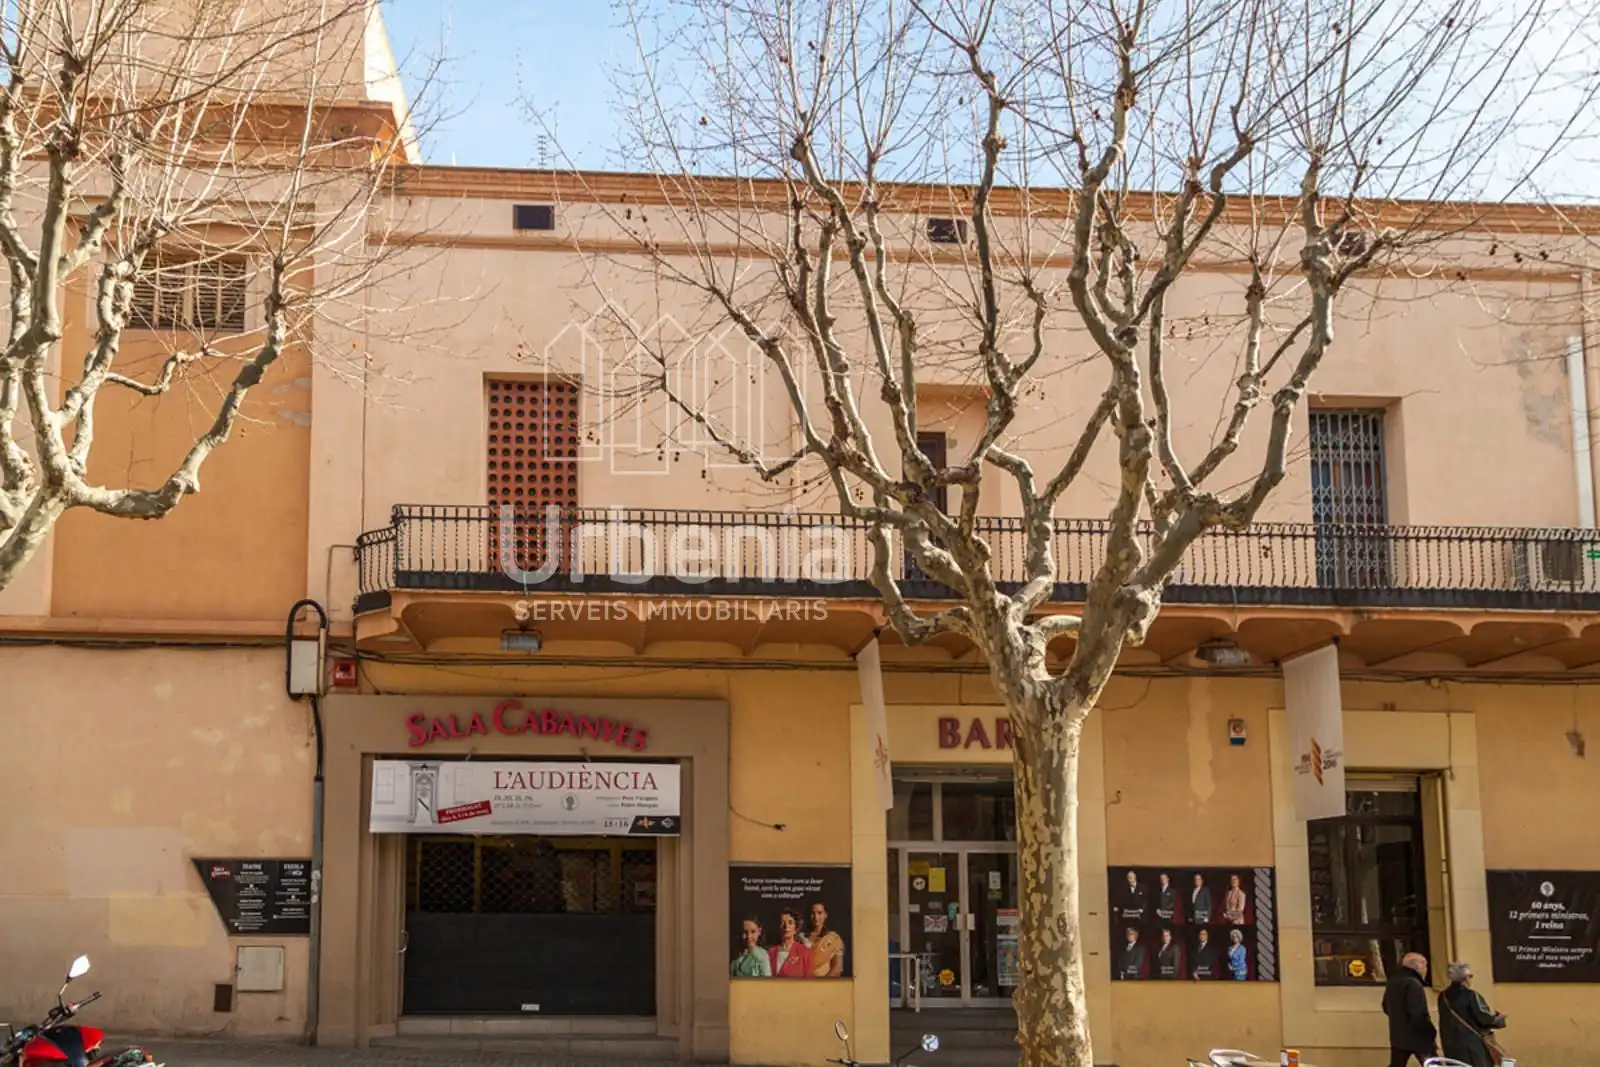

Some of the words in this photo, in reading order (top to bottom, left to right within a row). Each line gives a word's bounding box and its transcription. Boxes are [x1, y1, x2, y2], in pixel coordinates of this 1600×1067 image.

[406, 711, 487, 748] SALA
[492, 699, 648, 751] CABANYES
[938, 717, 1014, 750] BAR
[1509, 910, 1518, 919] 12
